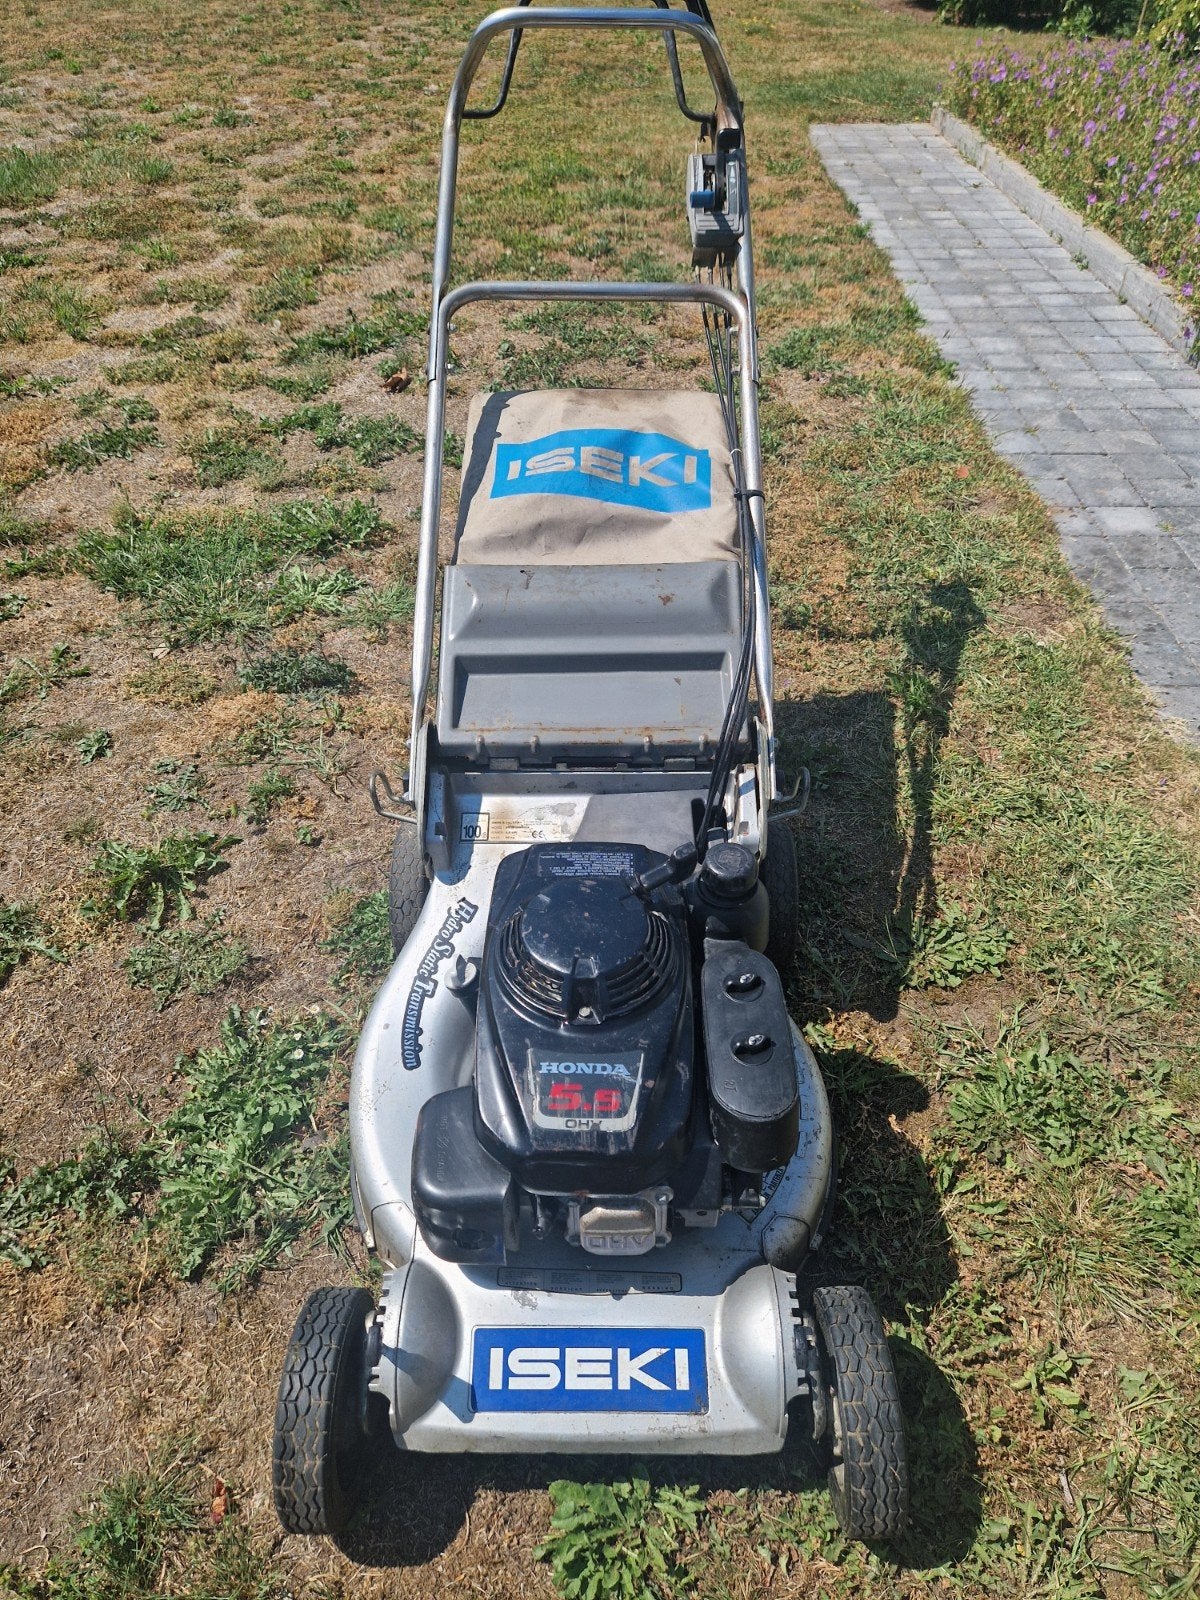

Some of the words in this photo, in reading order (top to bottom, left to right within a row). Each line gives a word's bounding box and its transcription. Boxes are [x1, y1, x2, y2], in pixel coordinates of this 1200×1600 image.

[506, 445, 698, 487] ISEKI
[463, 825, 481, 838] 100
[441, 897, 478, 938] Hydro
[419, 941, 453, 977] Static
[403, 978, 435, 1069] Transmission
[539, 1062, 631, 1075] HONDA
[565, 1119, 602, 1129] OHV
[584, 1234, 648, 1249] OHV
[489, 1347, 691, 1390] ISEKI
